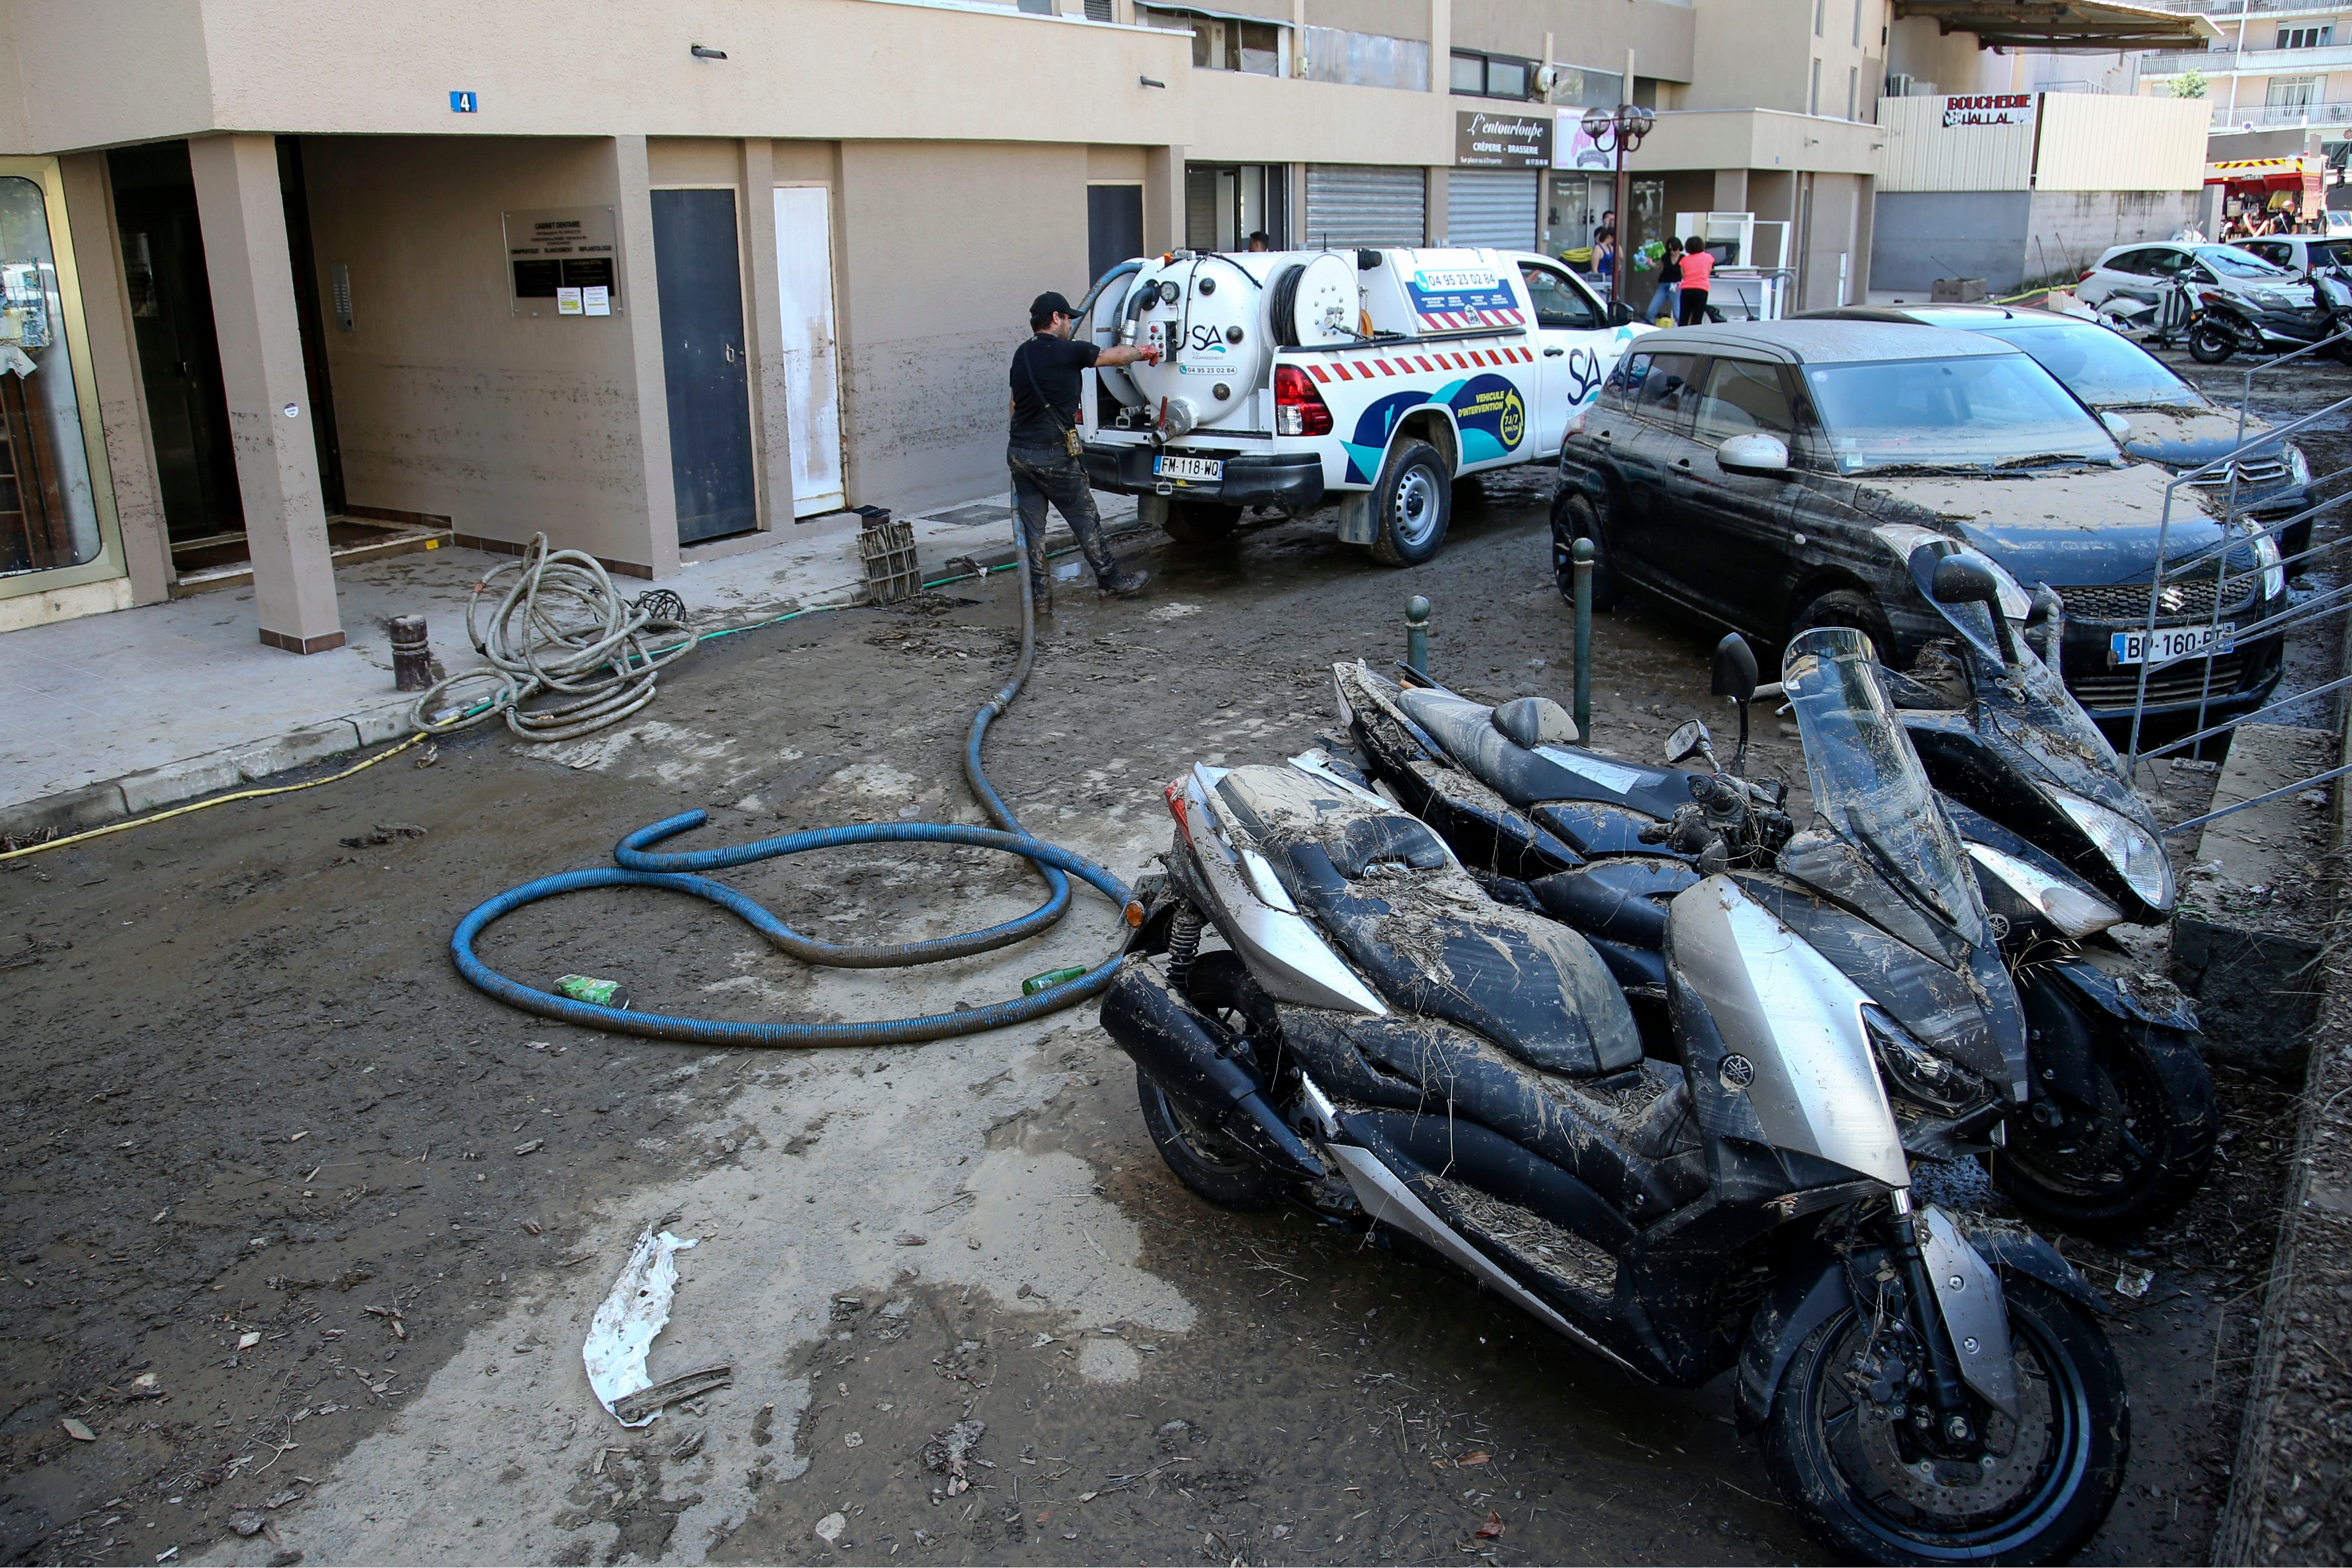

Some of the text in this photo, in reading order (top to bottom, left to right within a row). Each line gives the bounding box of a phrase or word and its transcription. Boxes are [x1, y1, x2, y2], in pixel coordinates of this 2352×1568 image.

[460, 93, 470, 111] 4
[1947, 94, 2031, 110] BOUCHERIE
[1962, 112, 2014, 125] HALLAL
[1467, 113, 1543, 143] L'entourloupe
[1473, 141, 1502, 153] CRÊPERIE
[1508, 144, 1539, 155] BRASSERIE
[1428, 273, 1495, 286] 04 95 23 02 84
[1476, 390, 1505, 403] VEHICULE
[1458, 401, 1504, 418] D'INTERVENTION
[1505, 414, 1518, 425] 7J/7
[1161, 457, 1218, 476] FM-118-WQ
